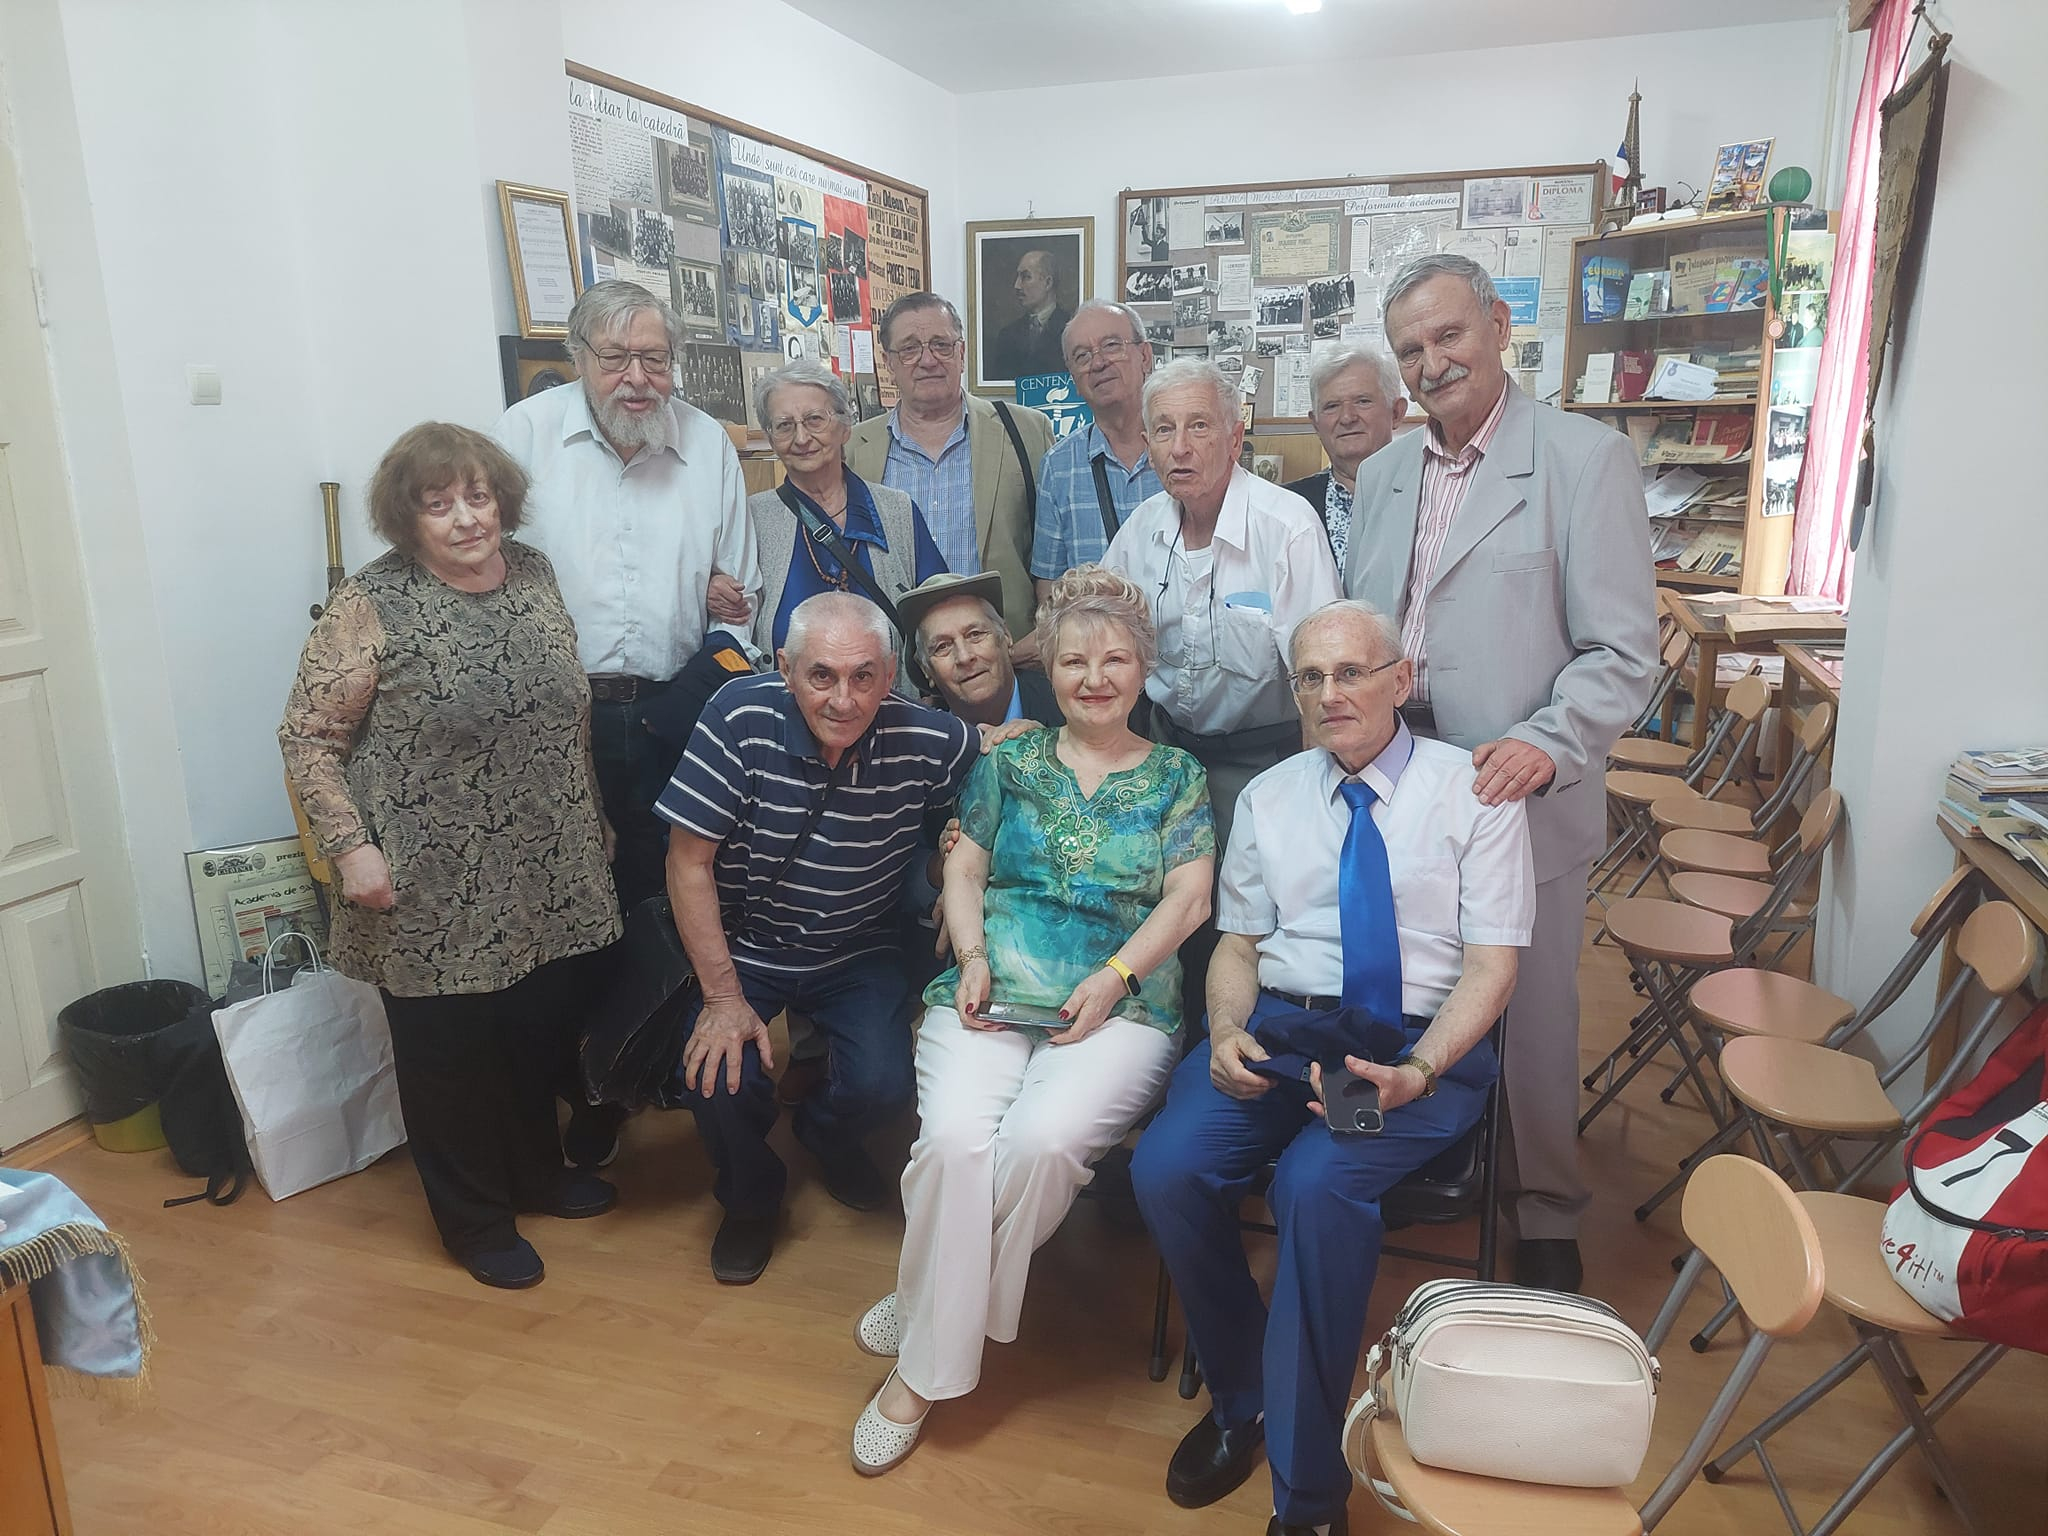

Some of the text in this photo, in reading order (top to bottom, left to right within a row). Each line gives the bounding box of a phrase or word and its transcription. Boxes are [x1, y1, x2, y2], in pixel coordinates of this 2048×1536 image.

[569, 80, 583, 108] la
[626, 98, 639, 123] la
[731, 137, 762, 167] Unde
[764, 158, 783, 175] sunt
[785, 165, 797, 178] cei
[799, 169, 817, 185] care
[1409, 196, 1457, 208] academice
[1542, 186, 1584, 195] DIPLOMA
[234, 887, 282, 906] Academia
[283, 886, 297, 896] de
[1940, 1128, 2034, 1188] 7
